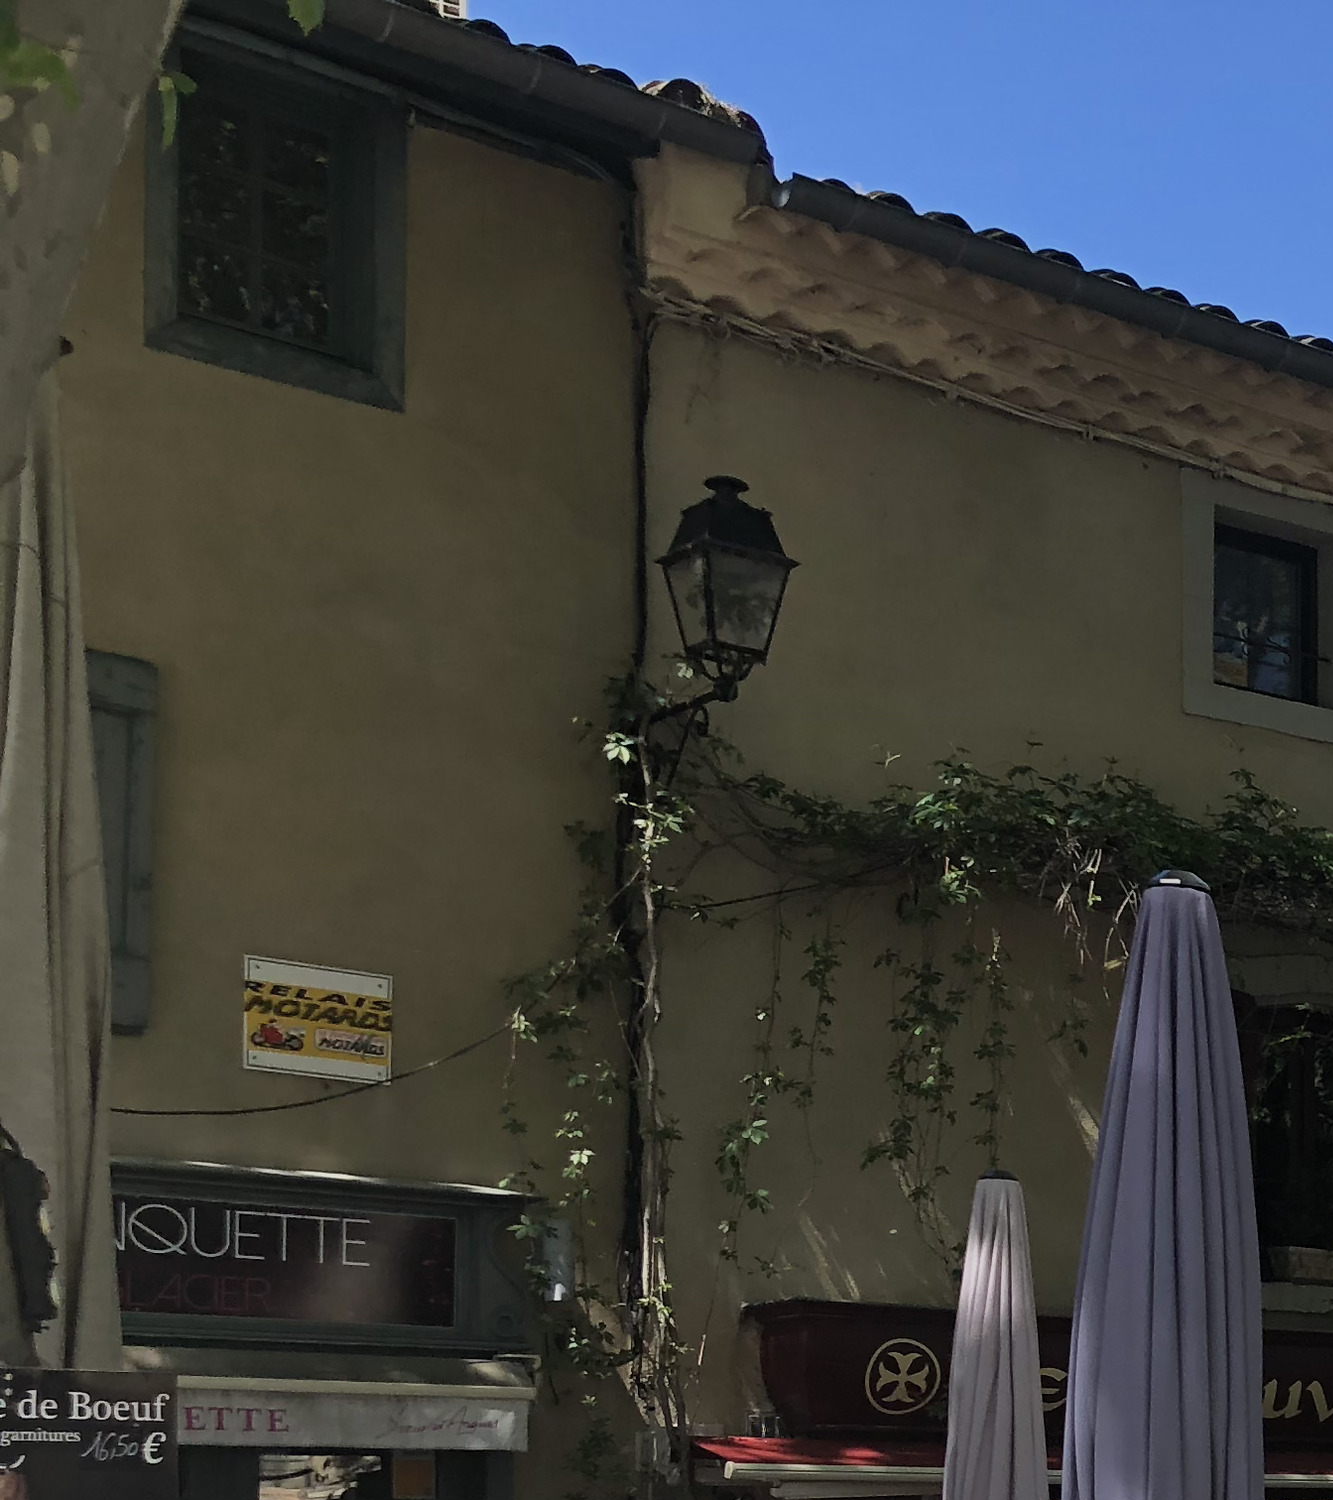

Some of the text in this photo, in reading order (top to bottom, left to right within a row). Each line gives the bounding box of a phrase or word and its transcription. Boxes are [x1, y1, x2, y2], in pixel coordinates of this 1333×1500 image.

[245, 981, 391, 1011] RELAIS
[17, 1390, 58, 1420] de
[68, 1391, 170, 1422] Boeuf
[1, 1427, 81, 1447] garnitures
[143, 1432, 167, 1464] €
